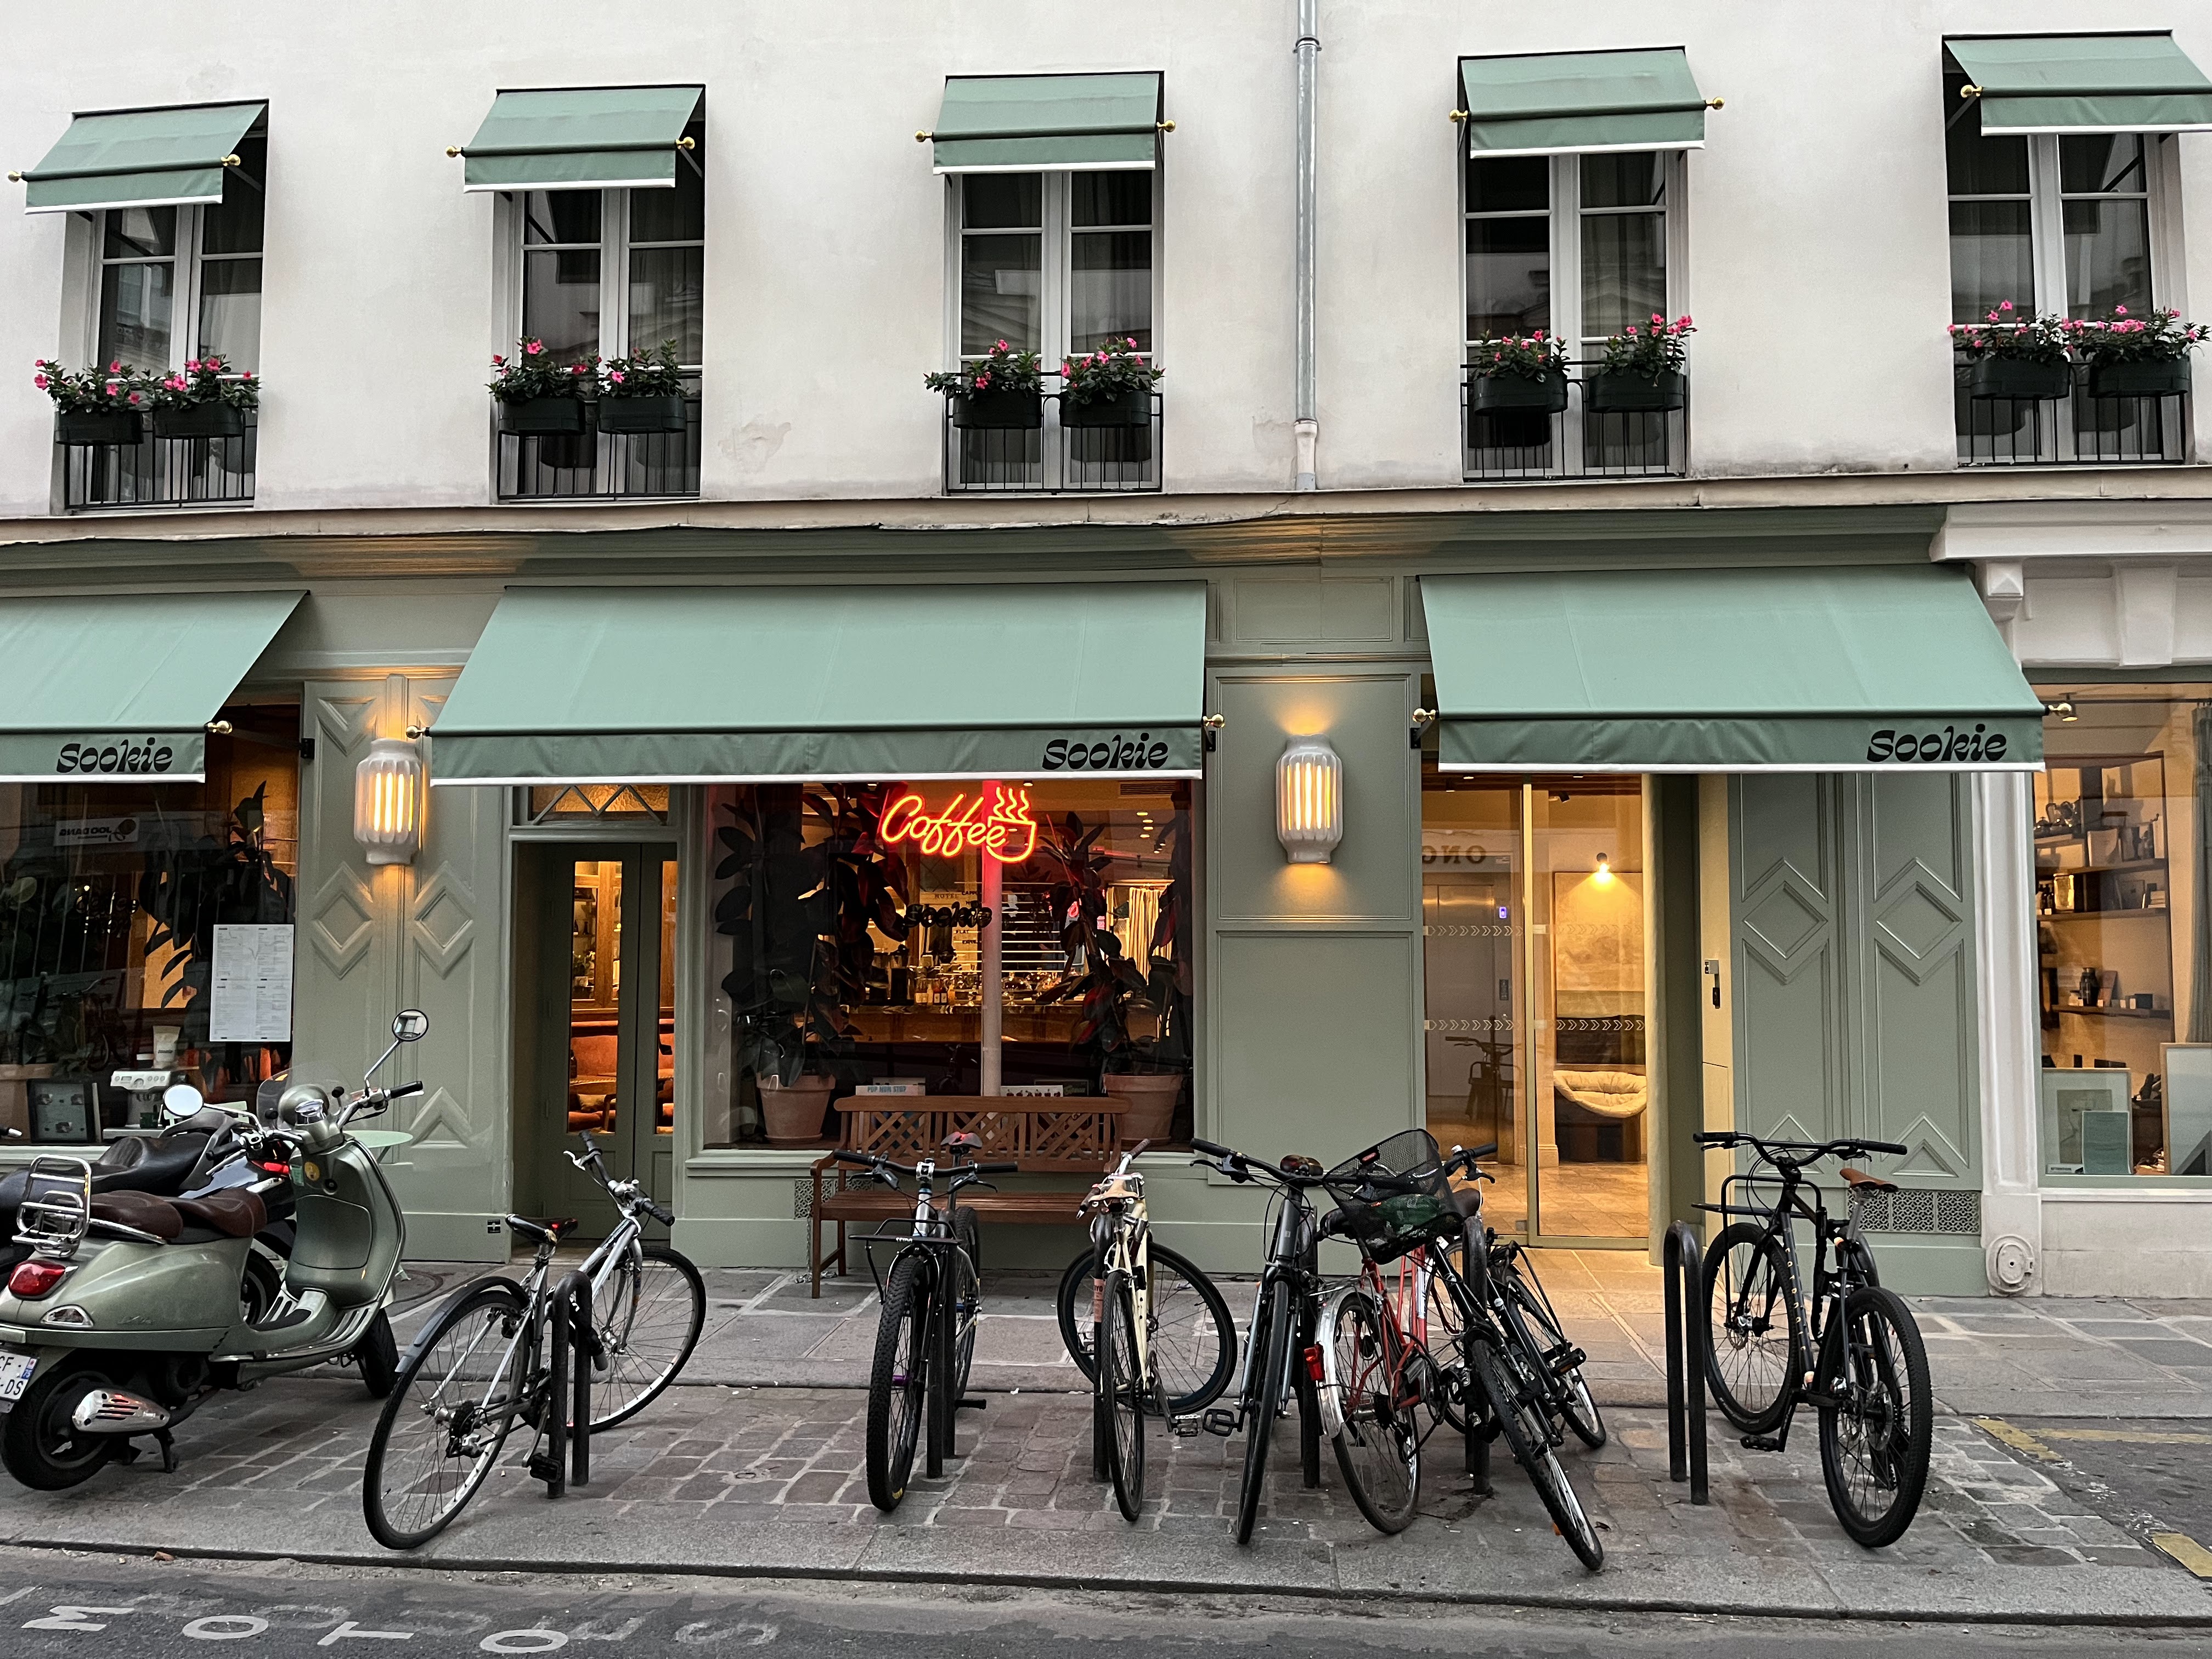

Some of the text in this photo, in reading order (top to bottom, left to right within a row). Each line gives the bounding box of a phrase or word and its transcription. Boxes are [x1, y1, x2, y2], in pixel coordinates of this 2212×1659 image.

[57, 737, 172, 774] Sookie
[1042, 732, 1169, 770] Sookie
[1866, 723, 2007, 763] Sookie
[881, 793, 1006, 856] Coffee
[904, 901, 992, 928] Sookie
